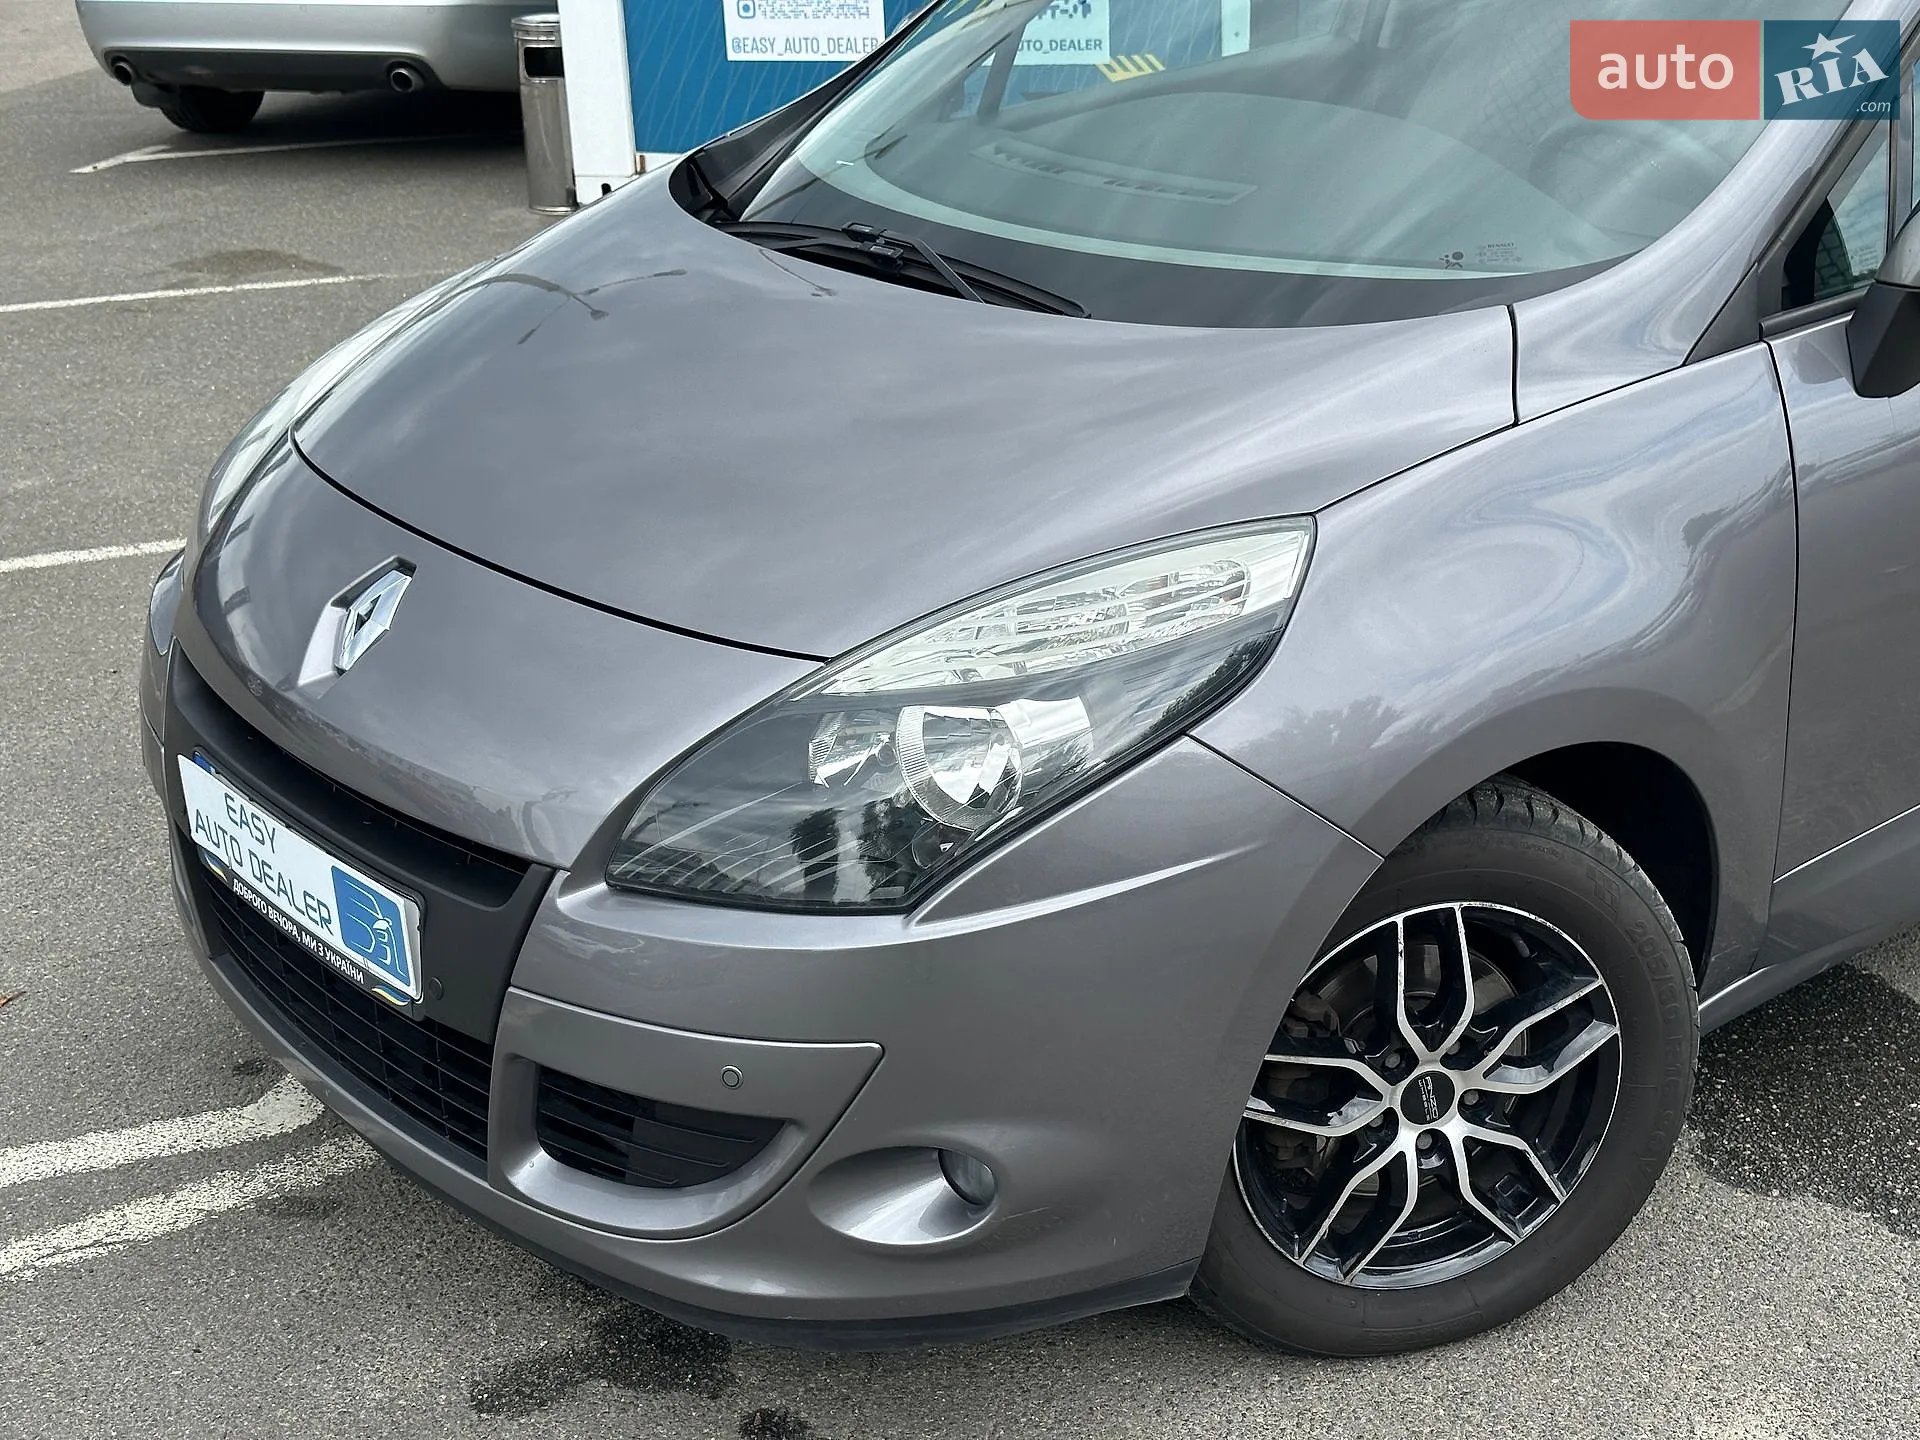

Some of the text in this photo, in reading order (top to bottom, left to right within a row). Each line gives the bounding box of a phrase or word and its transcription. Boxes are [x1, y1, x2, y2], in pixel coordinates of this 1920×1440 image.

[195, 808, 334, 936] AUTO DEALER
[224, 792, 275, 854] EASY
[233, 878, 268, 914] ДОБРОГО
[268, 905, 301, 942] ВЕЧОРА,
[302, 931, 318, 953] МИ
[323, 947, 364, 984] УКРАЇНИ
